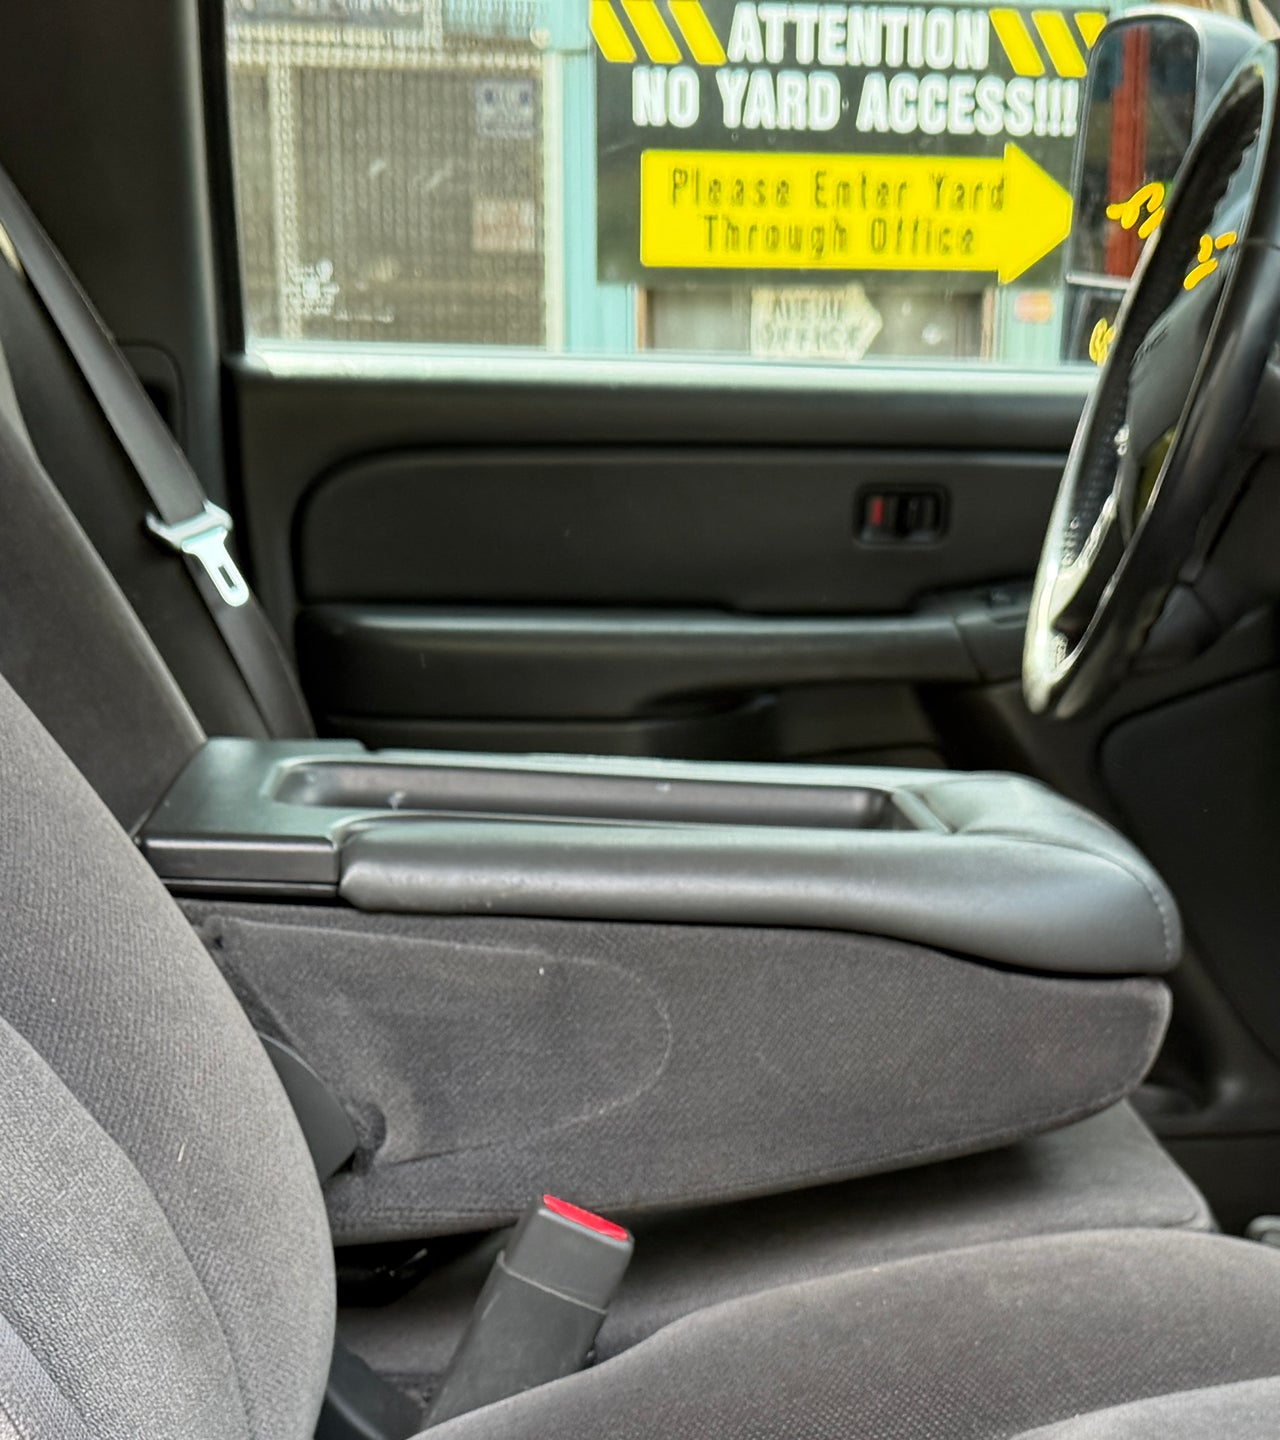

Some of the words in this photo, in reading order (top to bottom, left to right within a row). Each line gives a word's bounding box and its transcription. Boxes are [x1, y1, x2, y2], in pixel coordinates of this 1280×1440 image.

[727, 3, 990, 70] ATTENTION
[632, 66, 700, 128] NO
[716, 68, 841, 131] YARD
[855, 72, 1079, 137] ACCESS!!!
[672, 167, 790, 208] Please
[814, 169, 909, 211] Enter
[931, 173, 1006, 212] Yard
[702, 214, 849, 259] Through
[869, 217, 976, 256] Office
